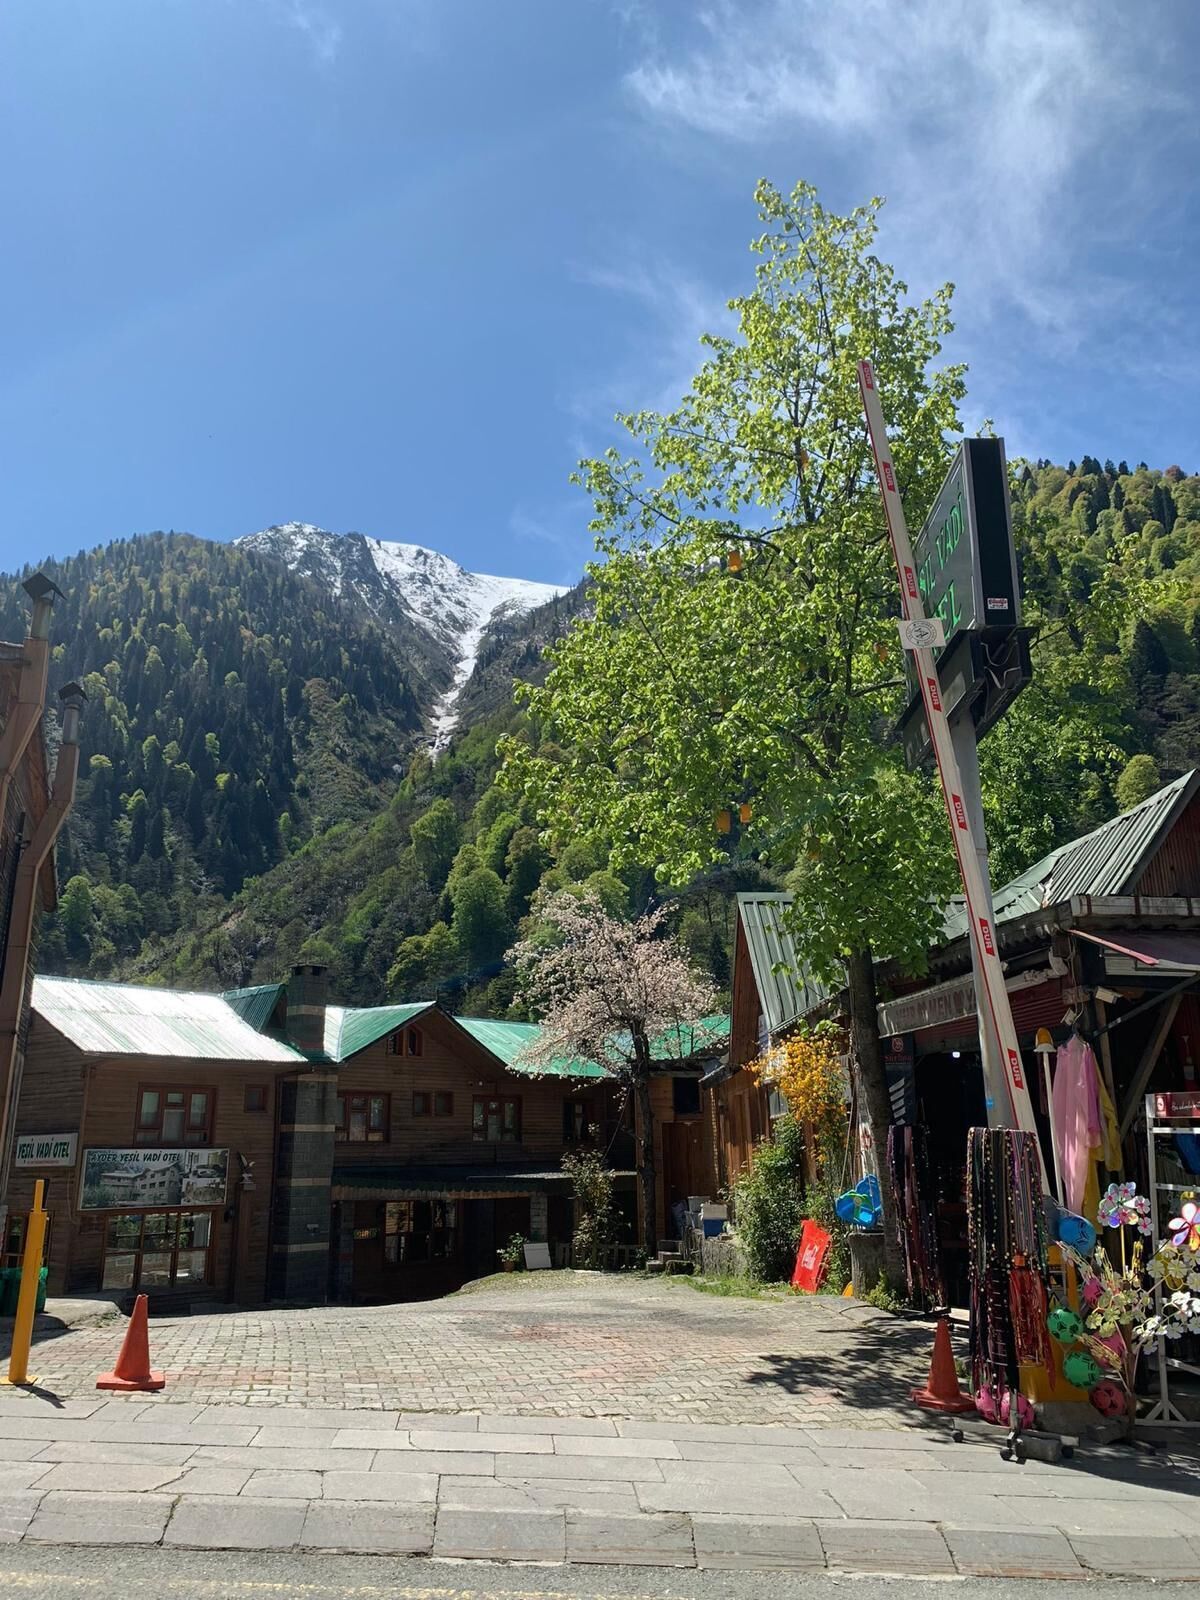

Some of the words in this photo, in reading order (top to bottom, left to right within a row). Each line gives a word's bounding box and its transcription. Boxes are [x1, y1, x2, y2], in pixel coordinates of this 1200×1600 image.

[863, 367, 872, 385] DUR
[884, 467, 893, 487] DUR
[905, 572, 915, 593] DUR
[929, 684, 939, 705] DUR
[954, 801, 965, 824] DUR
[981, 925, 992, 949] DUR
[1011, 1057, 1022, 1082] DUR
[17, 1138, 35, 1164] YEŞİL
[36, 1137, 54, 1158] VADİ
[53, 1141, 70, 1158] OTEL
[143, 1150, 162, 1162] VADİ
[163, 1153, 181, 1161] OTEL
